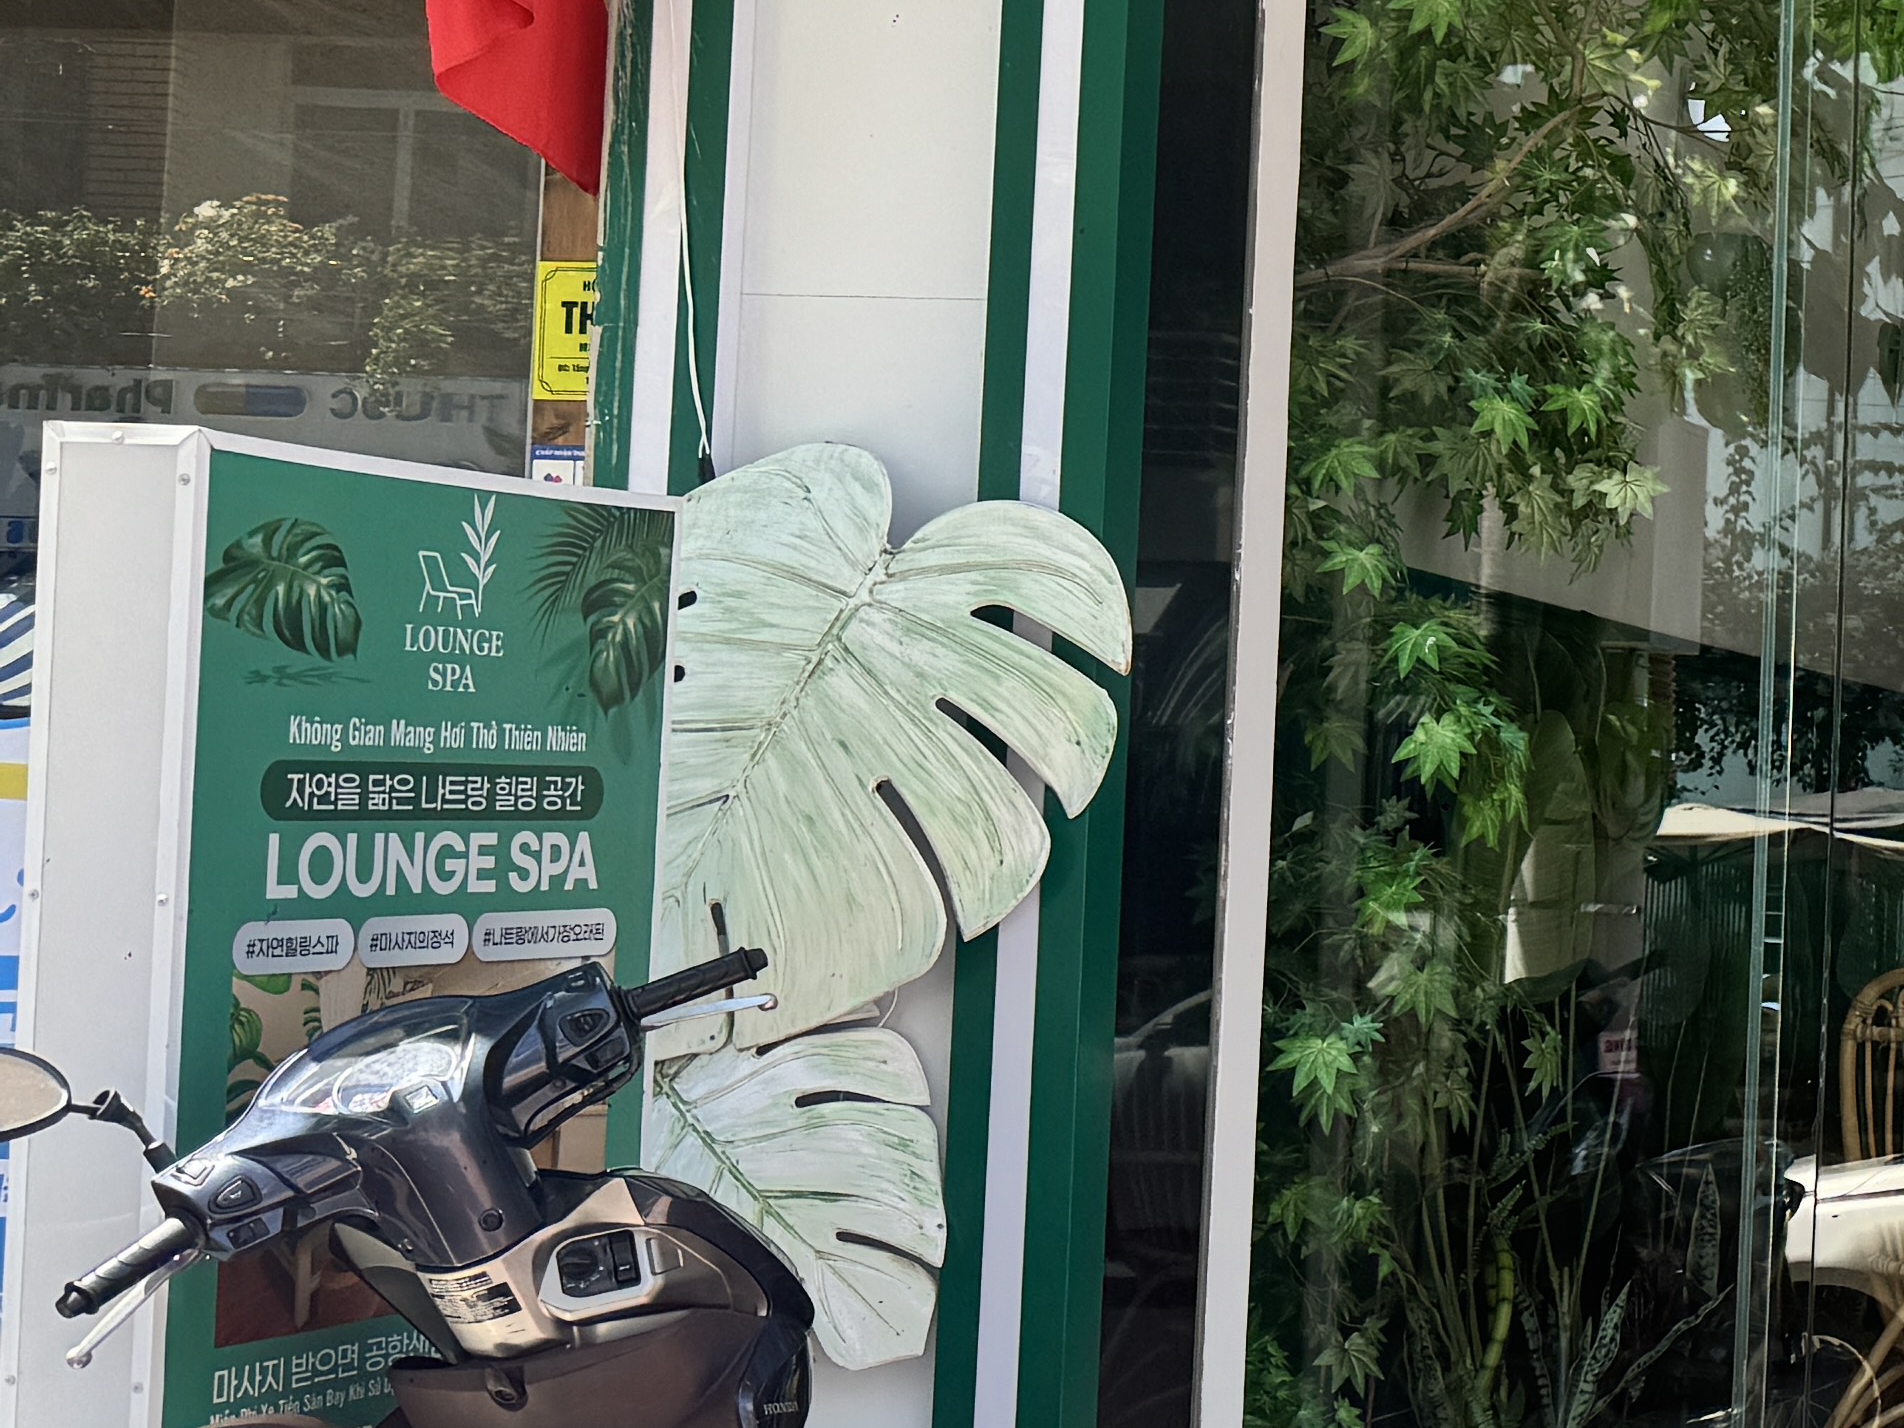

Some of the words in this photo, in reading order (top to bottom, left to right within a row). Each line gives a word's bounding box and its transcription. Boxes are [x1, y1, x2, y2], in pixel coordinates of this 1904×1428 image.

[404, 624, 504, 657] LOUNGE
[427, 662, 476, 693] SPA
[289, 715, 343, 752] Không
[349, 717, 384, 747] Gian
[390, 719, 434, 754] Mang
[503, 723, 542, 751] Thiên
[546, 724, 588, 752] Nhiên
[285, 772, 362, 812] 자연을
[367, 774, 415, 812] 닮은
[420, 775, 490, 812] 나트랑
[495, 776, 538, 812] 힐링
[541, 776, 585, 812] 공간
[266, 830, 498, 900] LOUNGE
[508, 829, 598, 894] SPA
[212, 1356, 285, 1404] 마사지
[291, 1342, 359, 1389] 받으면
[326, 1388, 346, 1409] Bay
